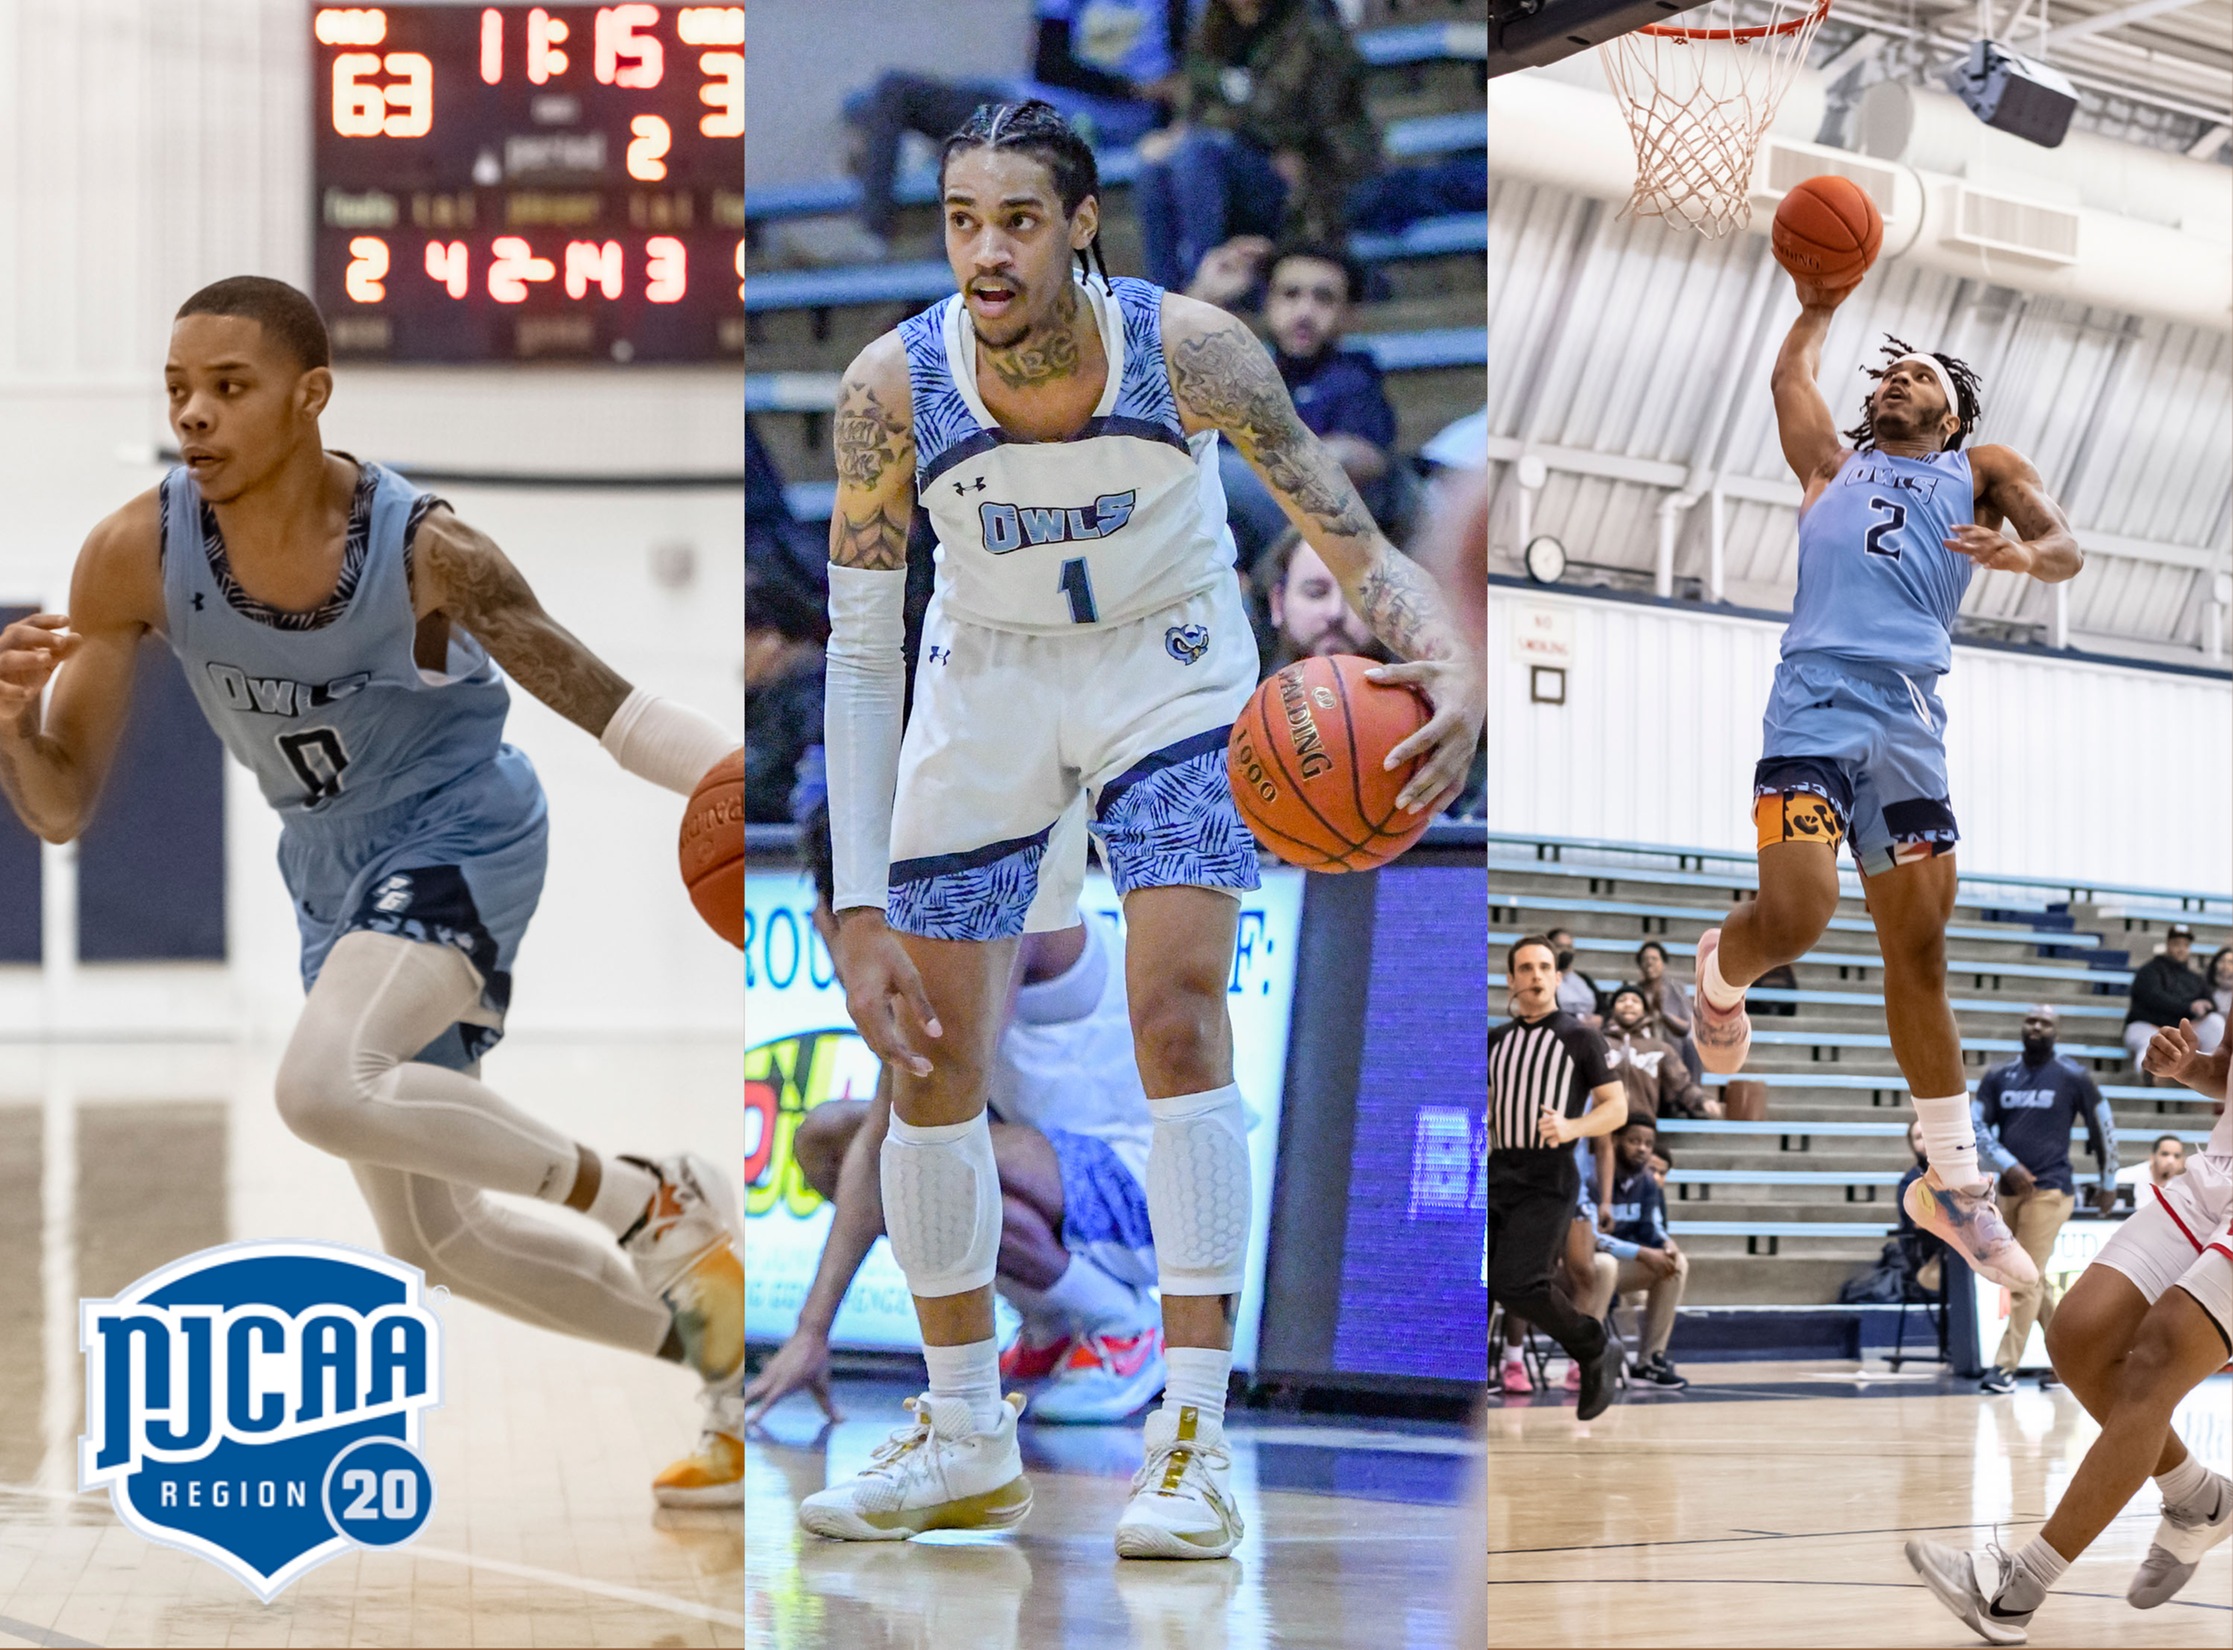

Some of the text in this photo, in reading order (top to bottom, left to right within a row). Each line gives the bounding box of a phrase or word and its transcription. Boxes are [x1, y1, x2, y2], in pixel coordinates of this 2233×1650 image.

[332, 52, 433, 137] 63
[627, 114, 671, 181] 2
[346, 236, 390, 302] 2
[425, 240, 468, 300] 4
[645, 236, 687, 302] 3
[978, 488, 1136, 555] OWLS
[1864, 495, 1907, 565] 2
[1057, 556, 1099, 624] 1
